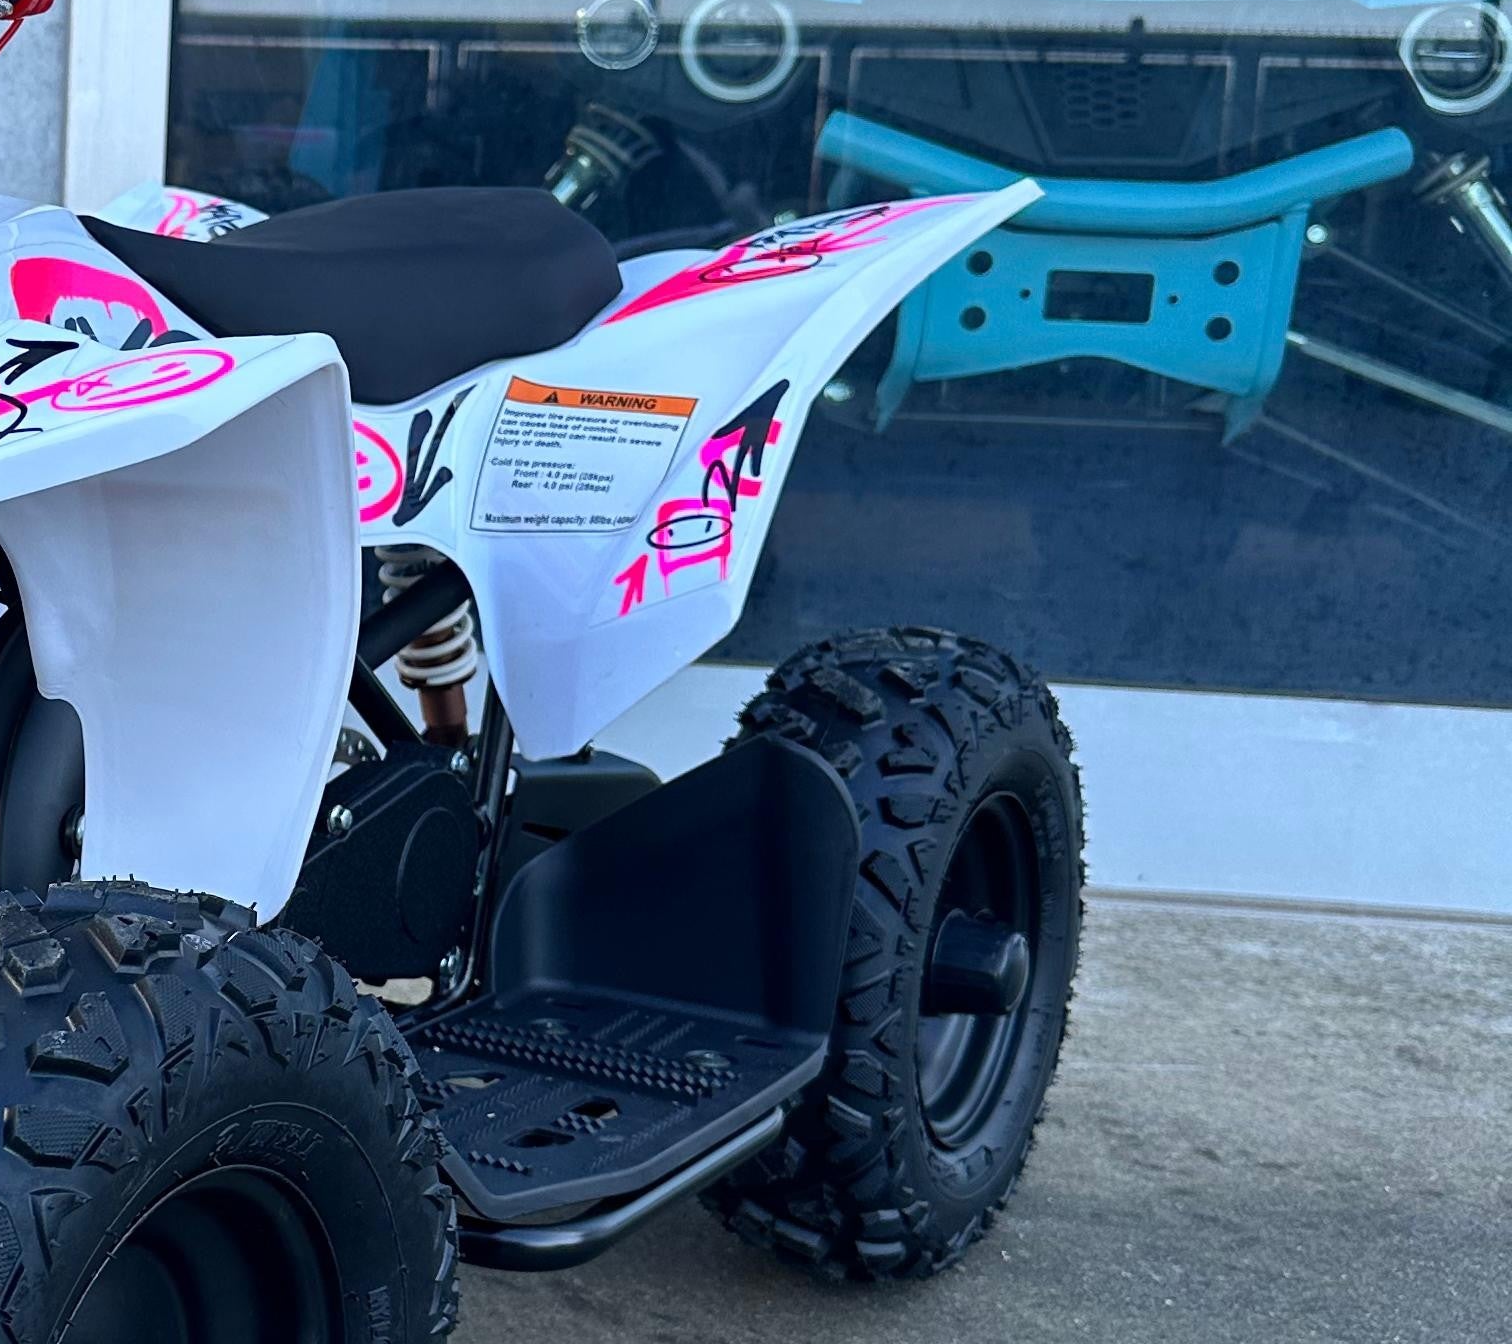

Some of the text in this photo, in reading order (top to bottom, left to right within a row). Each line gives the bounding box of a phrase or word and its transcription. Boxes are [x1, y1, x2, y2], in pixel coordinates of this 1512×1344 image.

[580, 393, 658, 410] WARNING
[500, 418, 518, 426] can
[549, 422, 569, 430] loss
[503, 408, 546, 420] Improper
[548, 412, 564, 421] tire
[565, 415, 607, 425] pressure
[622, 420, 679, 432] overloading
[497, 426, 520, 435] Loss
[533, 431, 567, 439] control
[568, 433, 586, 441] can
[588, 435, 616, 443] result
[617, 436, 627, 444] in
[629, 438, 662, 447] severe
[514, 459, 530, 468] tire
[514, 468, 539, 478] Front
[562, 472, 577, 481] psi
[511, 479, 533, 489] Rear
[558, 482, 574, 491] psi
[485, 513, 522, 525] Maximum
[523, 514, 550, 526] weight
